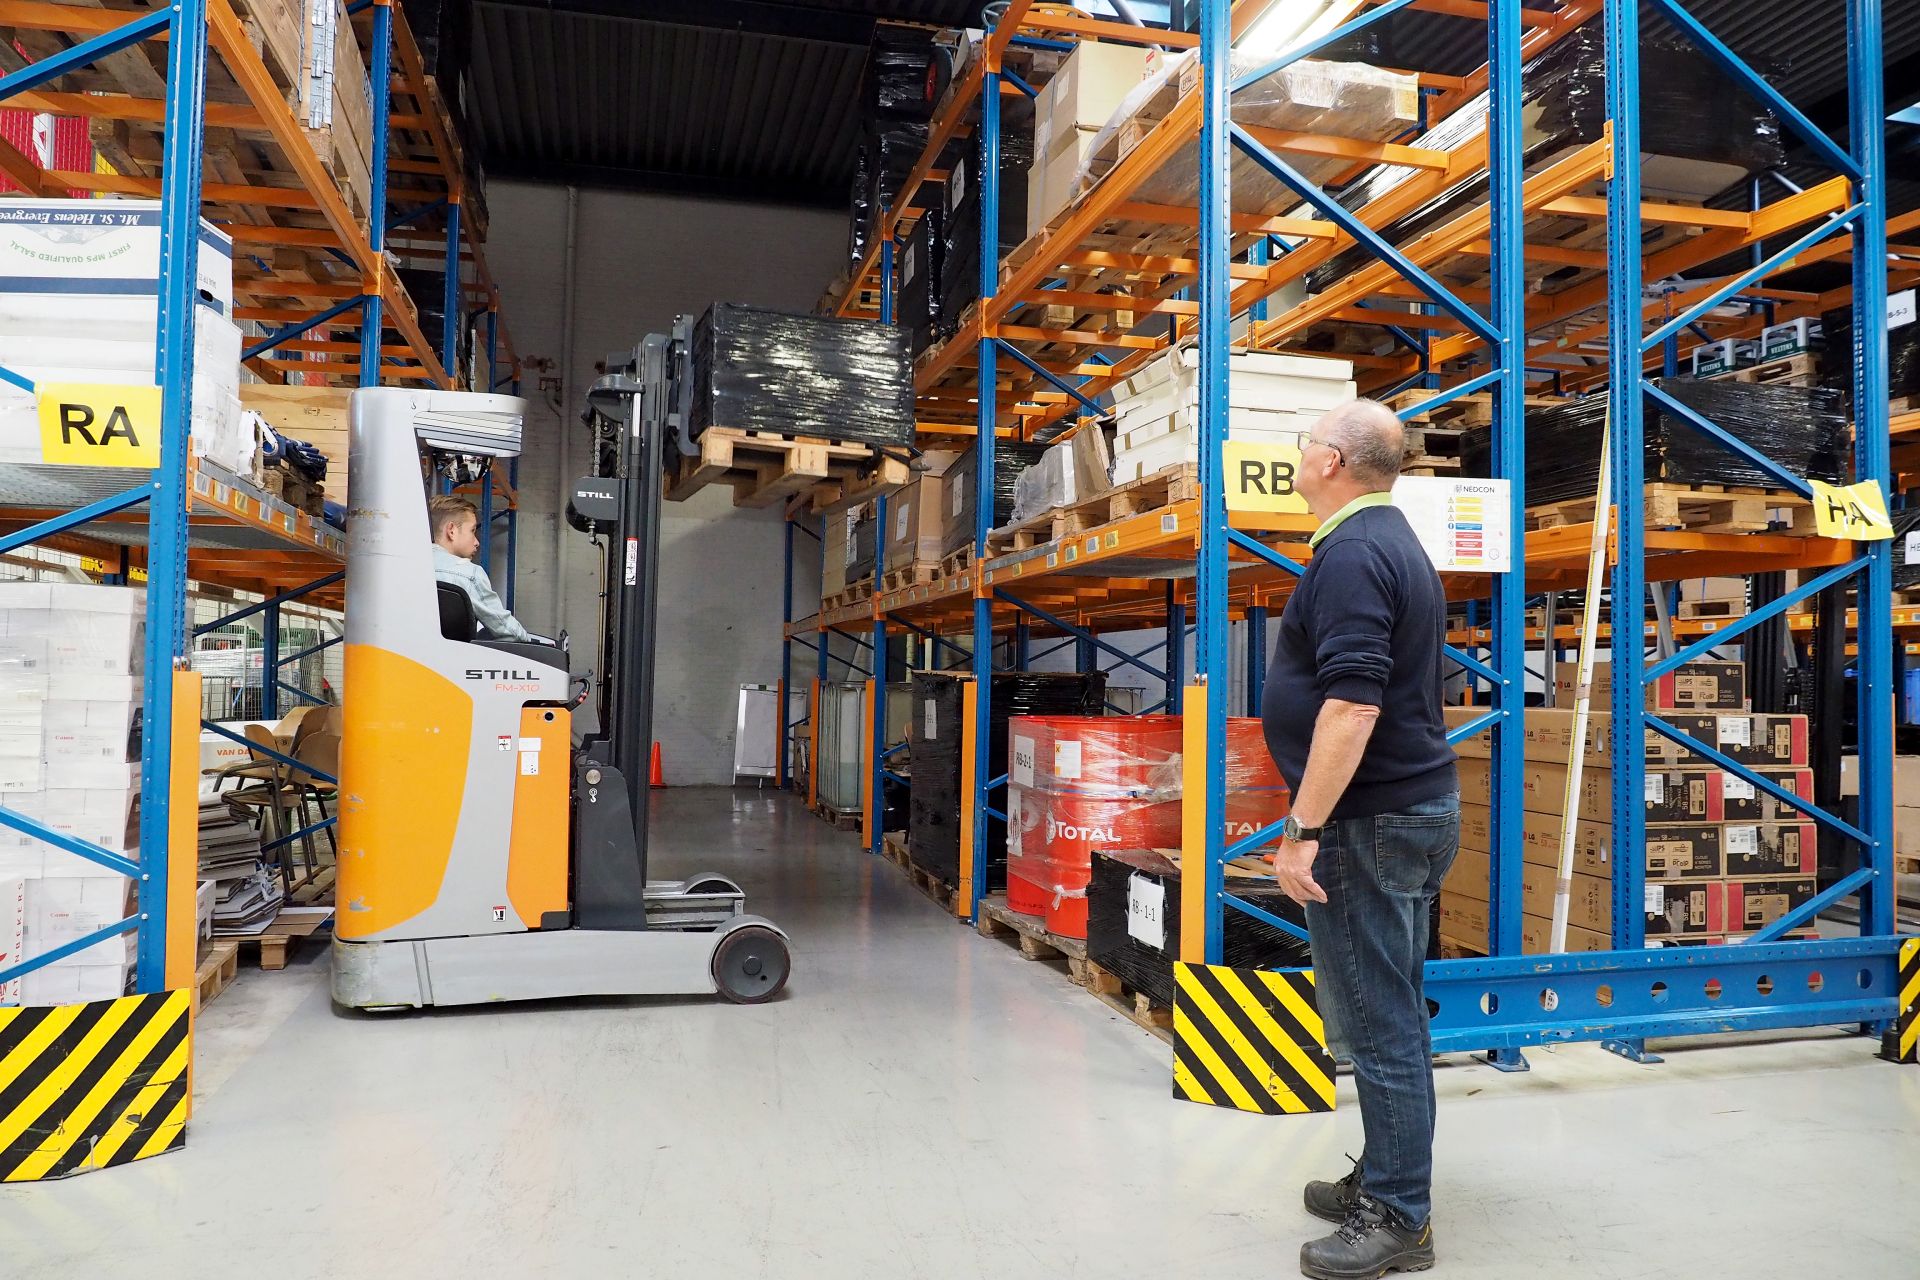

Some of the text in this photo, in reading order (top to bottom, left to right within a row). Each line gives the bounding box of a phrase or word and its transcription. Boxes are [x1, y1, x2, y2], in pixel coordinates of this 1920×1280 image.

[54, 213, 95, 225] Helens
[100, 214, 116, 225] St.
[118, 214, 141, 226] Mt.
[9, 240, 131, 264] FIRST MPS QUALIFIED SALAL
[59, 403, 141, 447] RA
[1240, 460, 1295, 496] RB
[577, 490, 614, 499] STILL
[1827, 494, 1874, 527] HA
[465, 669, 540, 680] STILL
[495, 683, 540, 692] FM-X10
[1016, 751, 1032, 769] RB-2-1
[1056, 821, 1122, 841] TOTAL
